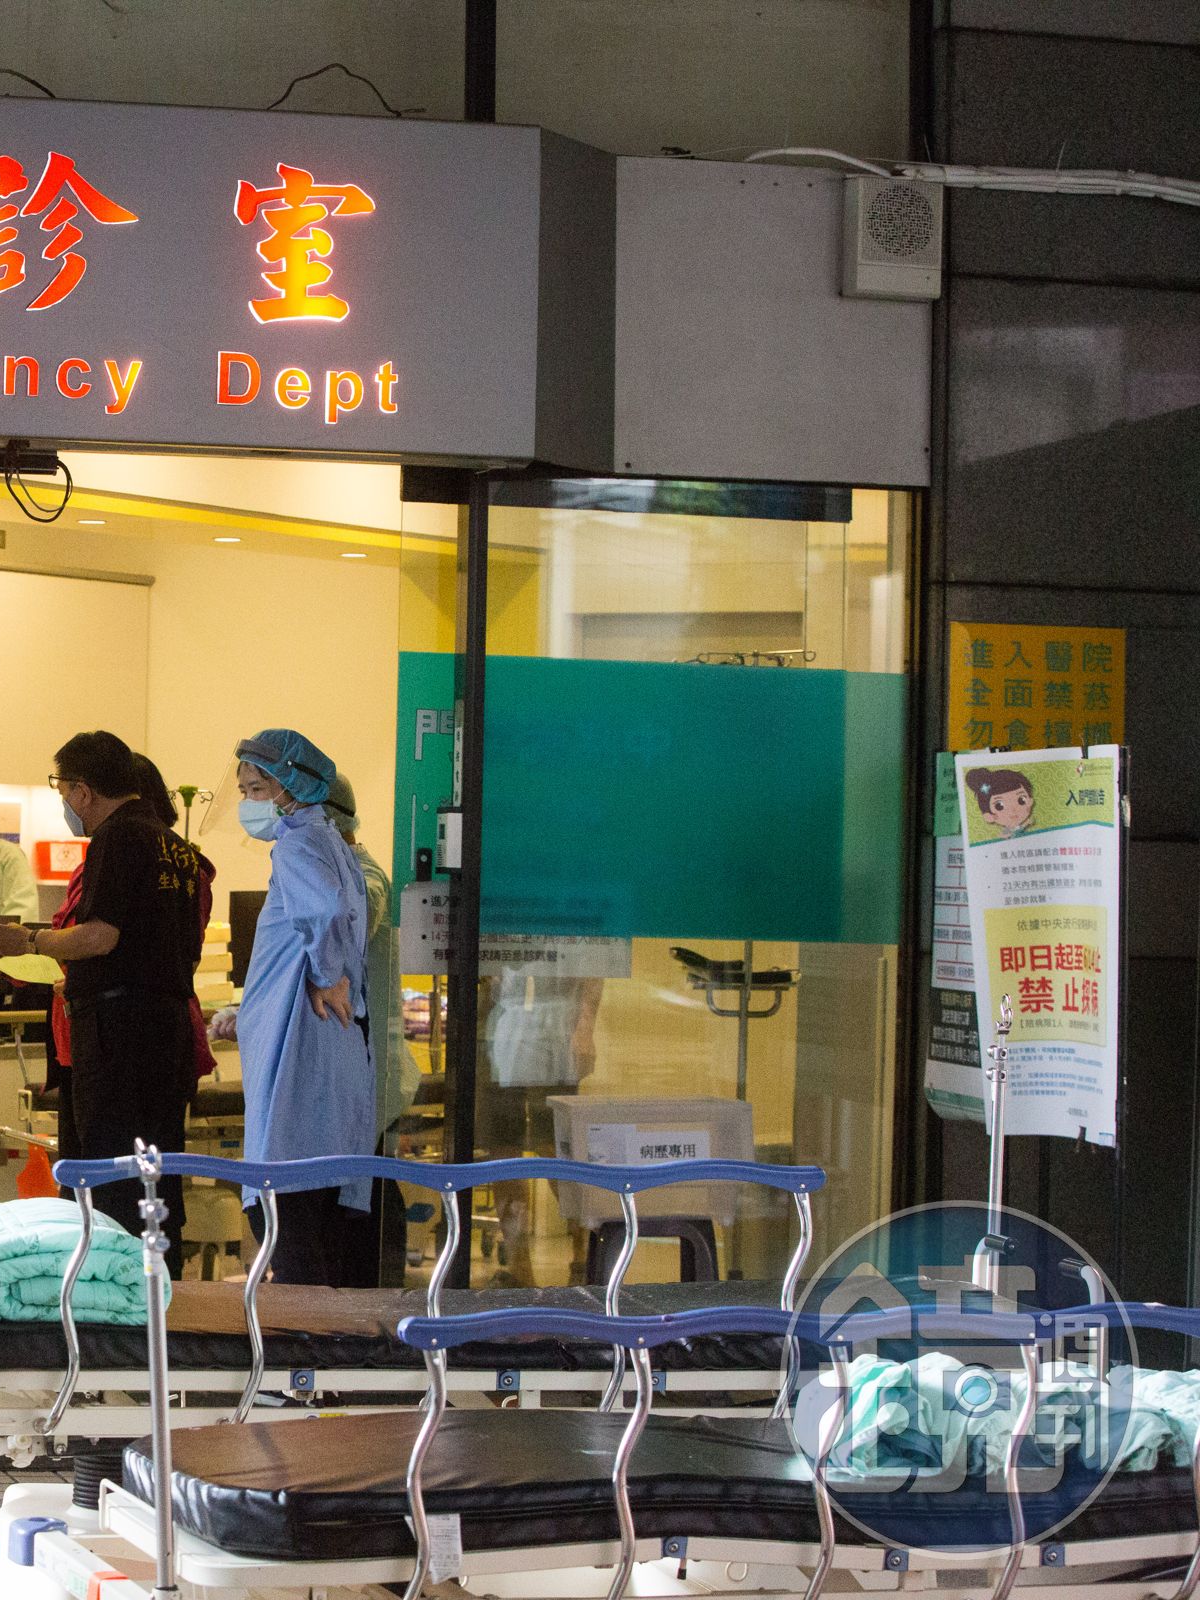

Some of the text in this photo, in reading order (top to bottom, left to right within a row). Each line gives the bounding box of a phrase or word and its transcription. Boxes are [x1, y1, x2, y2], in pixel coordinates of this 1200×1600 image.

[216, 350, 399, 425] Dept
[964, 639, 1113, 673] 進入醫院
[640, 1144, 696, 1159] 病歷專用
